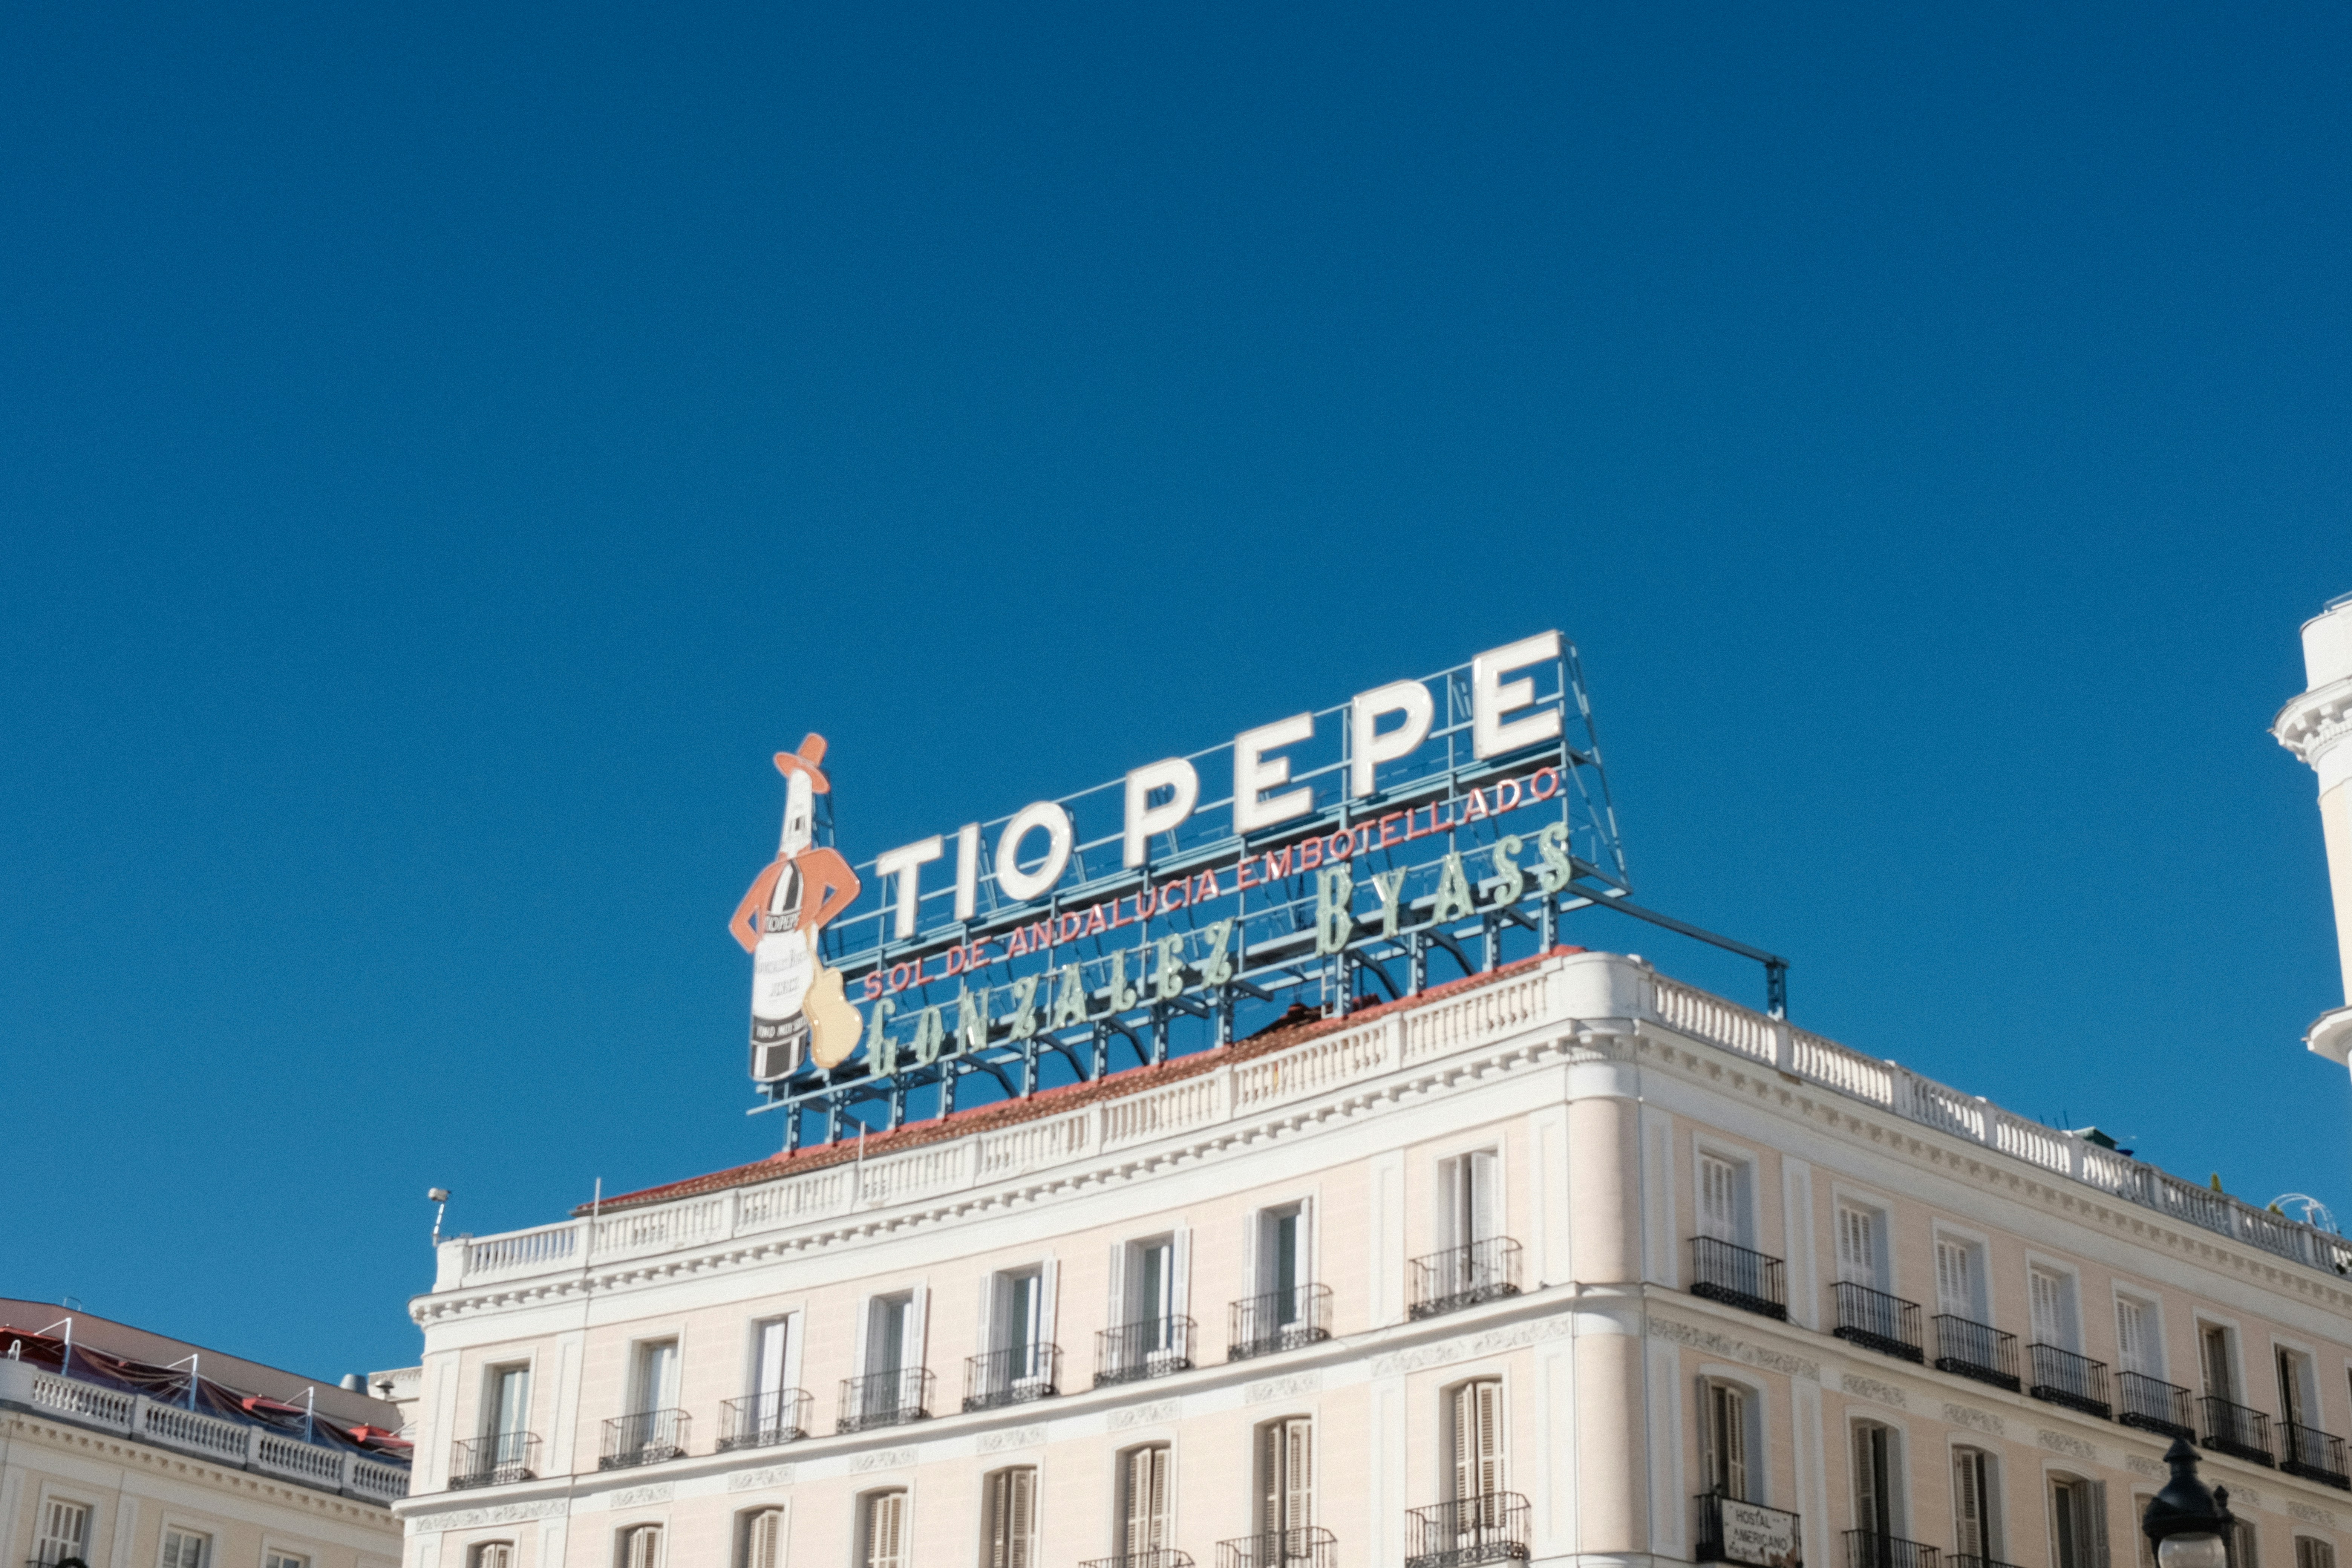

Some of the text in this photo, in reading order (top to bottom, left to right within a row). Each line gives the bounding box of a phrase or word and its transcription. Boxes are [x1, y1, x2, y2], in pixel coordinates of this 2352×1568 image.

[864, 766, 1559, 1000] SOL DE ANDALUCIA EMBOTELLADO
[875, 629, 1562, 939] TIO PEPE
[868, 821, 1572, 1078] GONZALEZ BYASS
[1733, 1528, 1788, 1551] AMERICANO
[1735, 1509, 1771, 1529] HOSTAL
